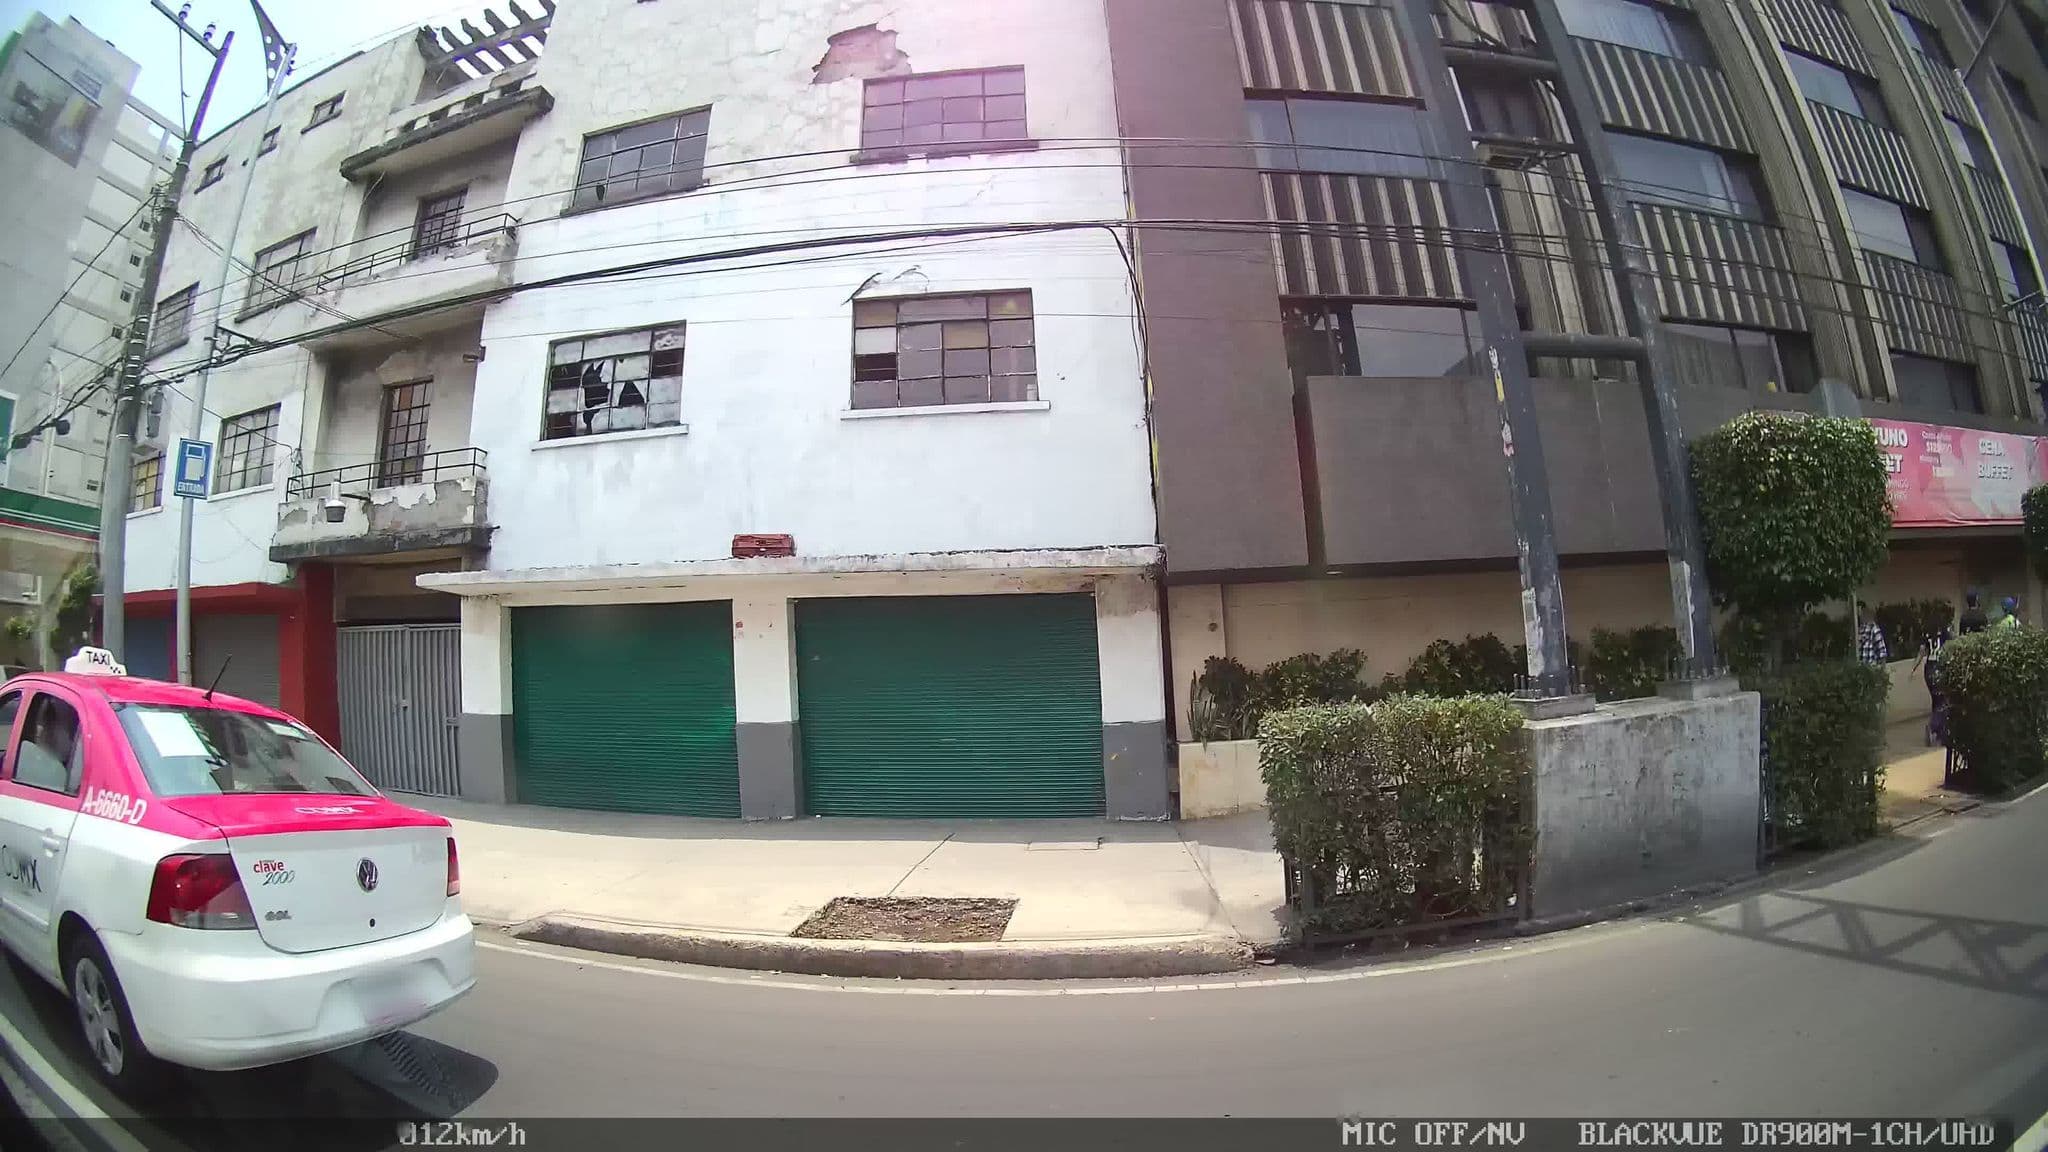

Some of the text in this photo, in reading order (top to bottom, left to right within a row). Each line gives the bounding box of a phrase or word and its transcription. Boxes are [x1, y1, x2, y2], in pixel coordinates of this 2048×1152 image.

[86, 650, 110, 666] TAXI
[81, 785, 147, 825] A-6660-D
[253, 859, 285, 873] clave
